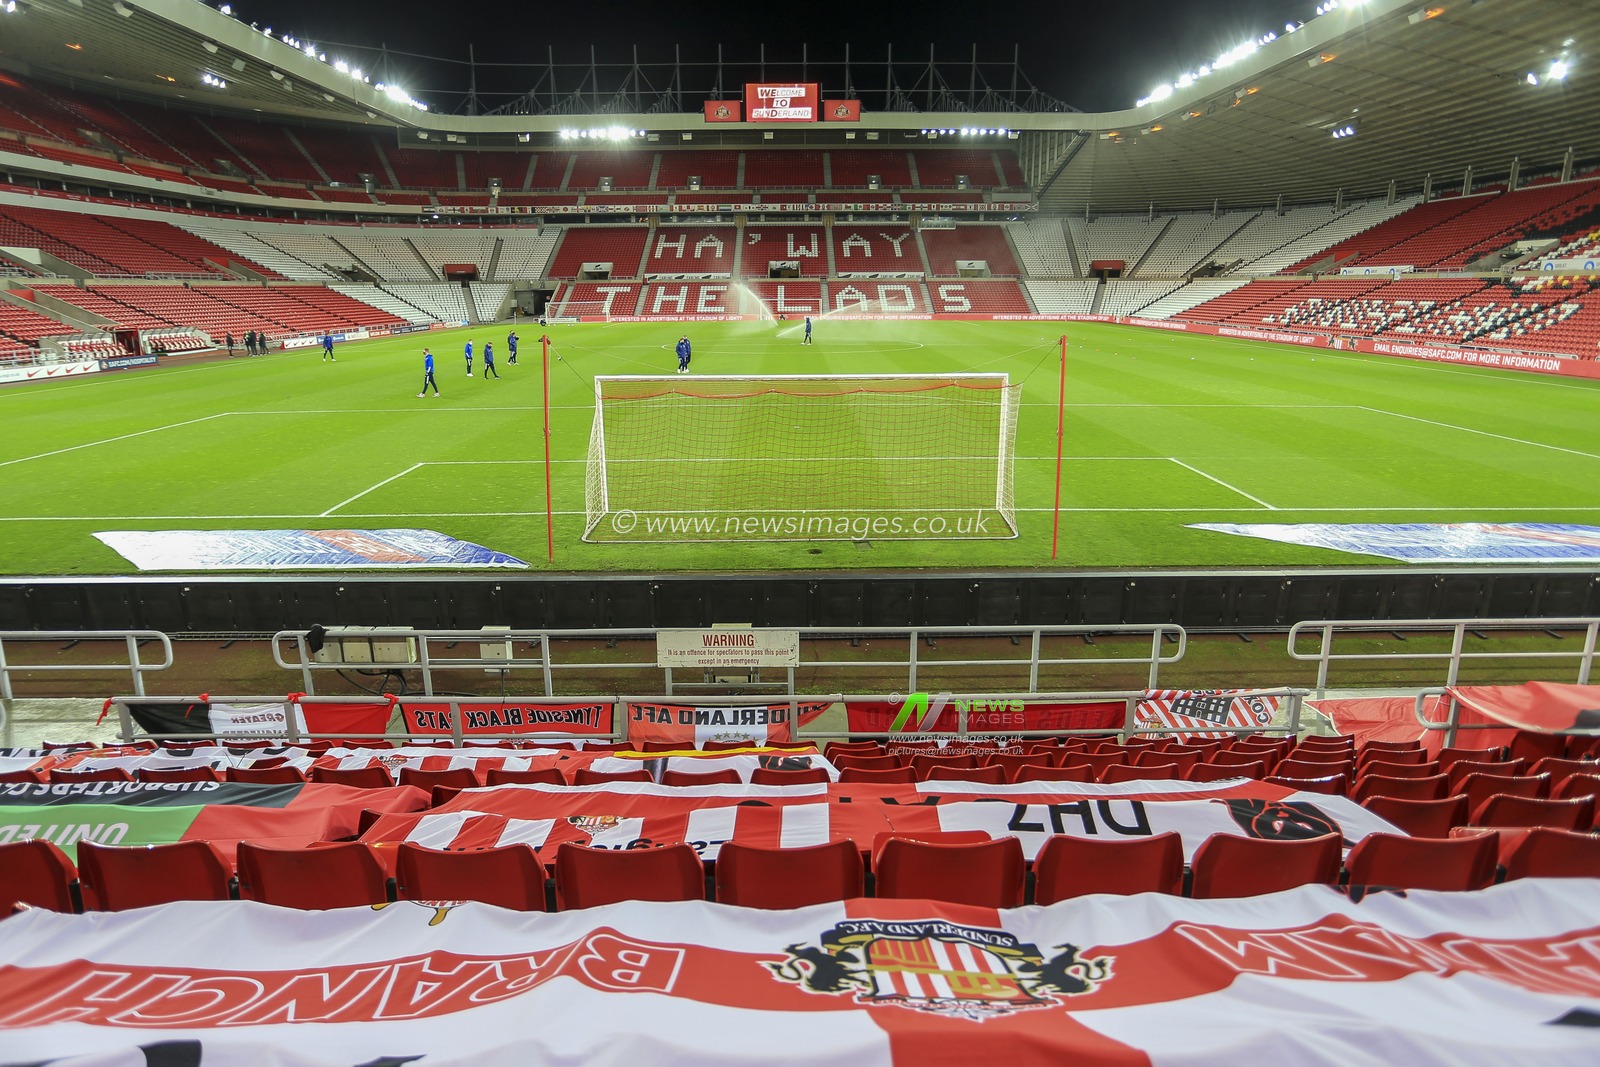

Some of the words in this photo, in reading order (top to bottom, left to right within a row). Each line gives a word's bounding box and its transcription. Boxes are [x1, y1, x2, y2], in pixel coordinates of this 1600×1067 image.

[759, 89, 804, 97] WELCOME
[753, 109, 810, 118] SUNDERLAND
[595, 285, 729, 314] THE
[777, 284, 972, 312] LADS
[1241, 330, 1263, 339] ADVERTISING
[1268, 332, 1277, 340] THE
[1276, 333, 1293, 342] STADIUM
[1299, 336, 1315, 344] LIGHT?
[1373, 343, 1391, 353] EMAIL
[1391, 344, 1462, 360] ENQUIRIES@SAFC.COM
[1463, 352, 1477, 362] FOR
[1478, 354, 1501, 364] MORE
[1502, 355, 1561, 371] INFORMATION
[702, 634, 755, 647] WARNING
[716, 649, 743, 657] spectators
[775, 649, 789, 657] point
[698, 658, 716, 666] except
[839, 921, 885, 934] A.F.C.
[887, 922, 1014, 947] SUNDERLAND
[0, 932, 687, 1028] BRANCH
